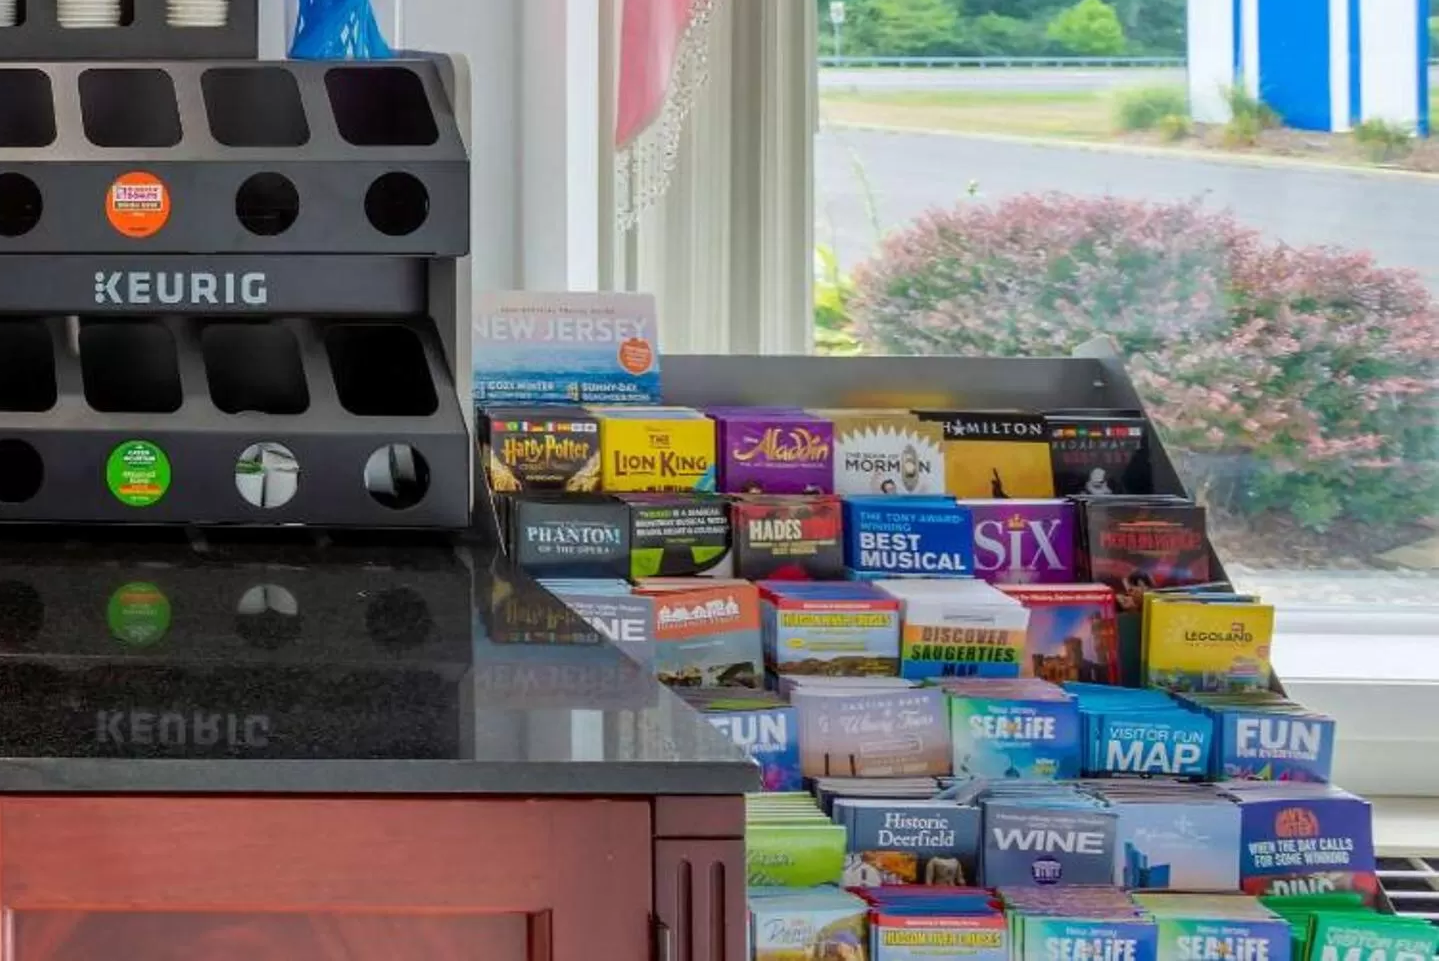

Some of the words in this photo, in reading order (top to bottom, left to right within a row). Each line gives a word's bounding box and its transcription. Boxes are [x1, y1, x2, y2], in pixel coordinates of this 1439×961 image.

[94, 271, 268, 305] KEURIG
[472, 315, 535, 341] NEW
[543, 315, 647, 341] JERSEY
[614, 450, 655, 476] LION
[661, 451, 708, 477] KING
[860, 512, 881, 521] THE
[886, 513, 917, 523] TONY
[527, 525, 621, 544] PHANTOM
[749, 519, 802, 541] HADES
[860, 532, 921, 551] BEST
[860, 551, 967, 571] MUSICAL
[922, 626, 1009, 645] DISCOVER
[911, 644, 1016, 662] SAUGERTIES
[941, 663, 979, 677] MAP
[970, 714, 1009, 739] SEA
[1110, 727, 1168, 740] VISITOR
[1173, 729, 1204, 743] FUN
[1236, 718, 1321, 752] FUN
[1107, 740, 1202, 773] MAP
[884, 812, 949, 831] Historic
[878, 830, 955, 847] Deerfield
[993, 827, 1105, 854] WINE
[1248, 841, 1275, 855] WHEN
[1277, 839, 1296, 853] THE
[1320, 837, 1353, 851] CALLS
[1254, 854, 1273, 868] FOR
[1275, 853, 1302, 866] SOME
